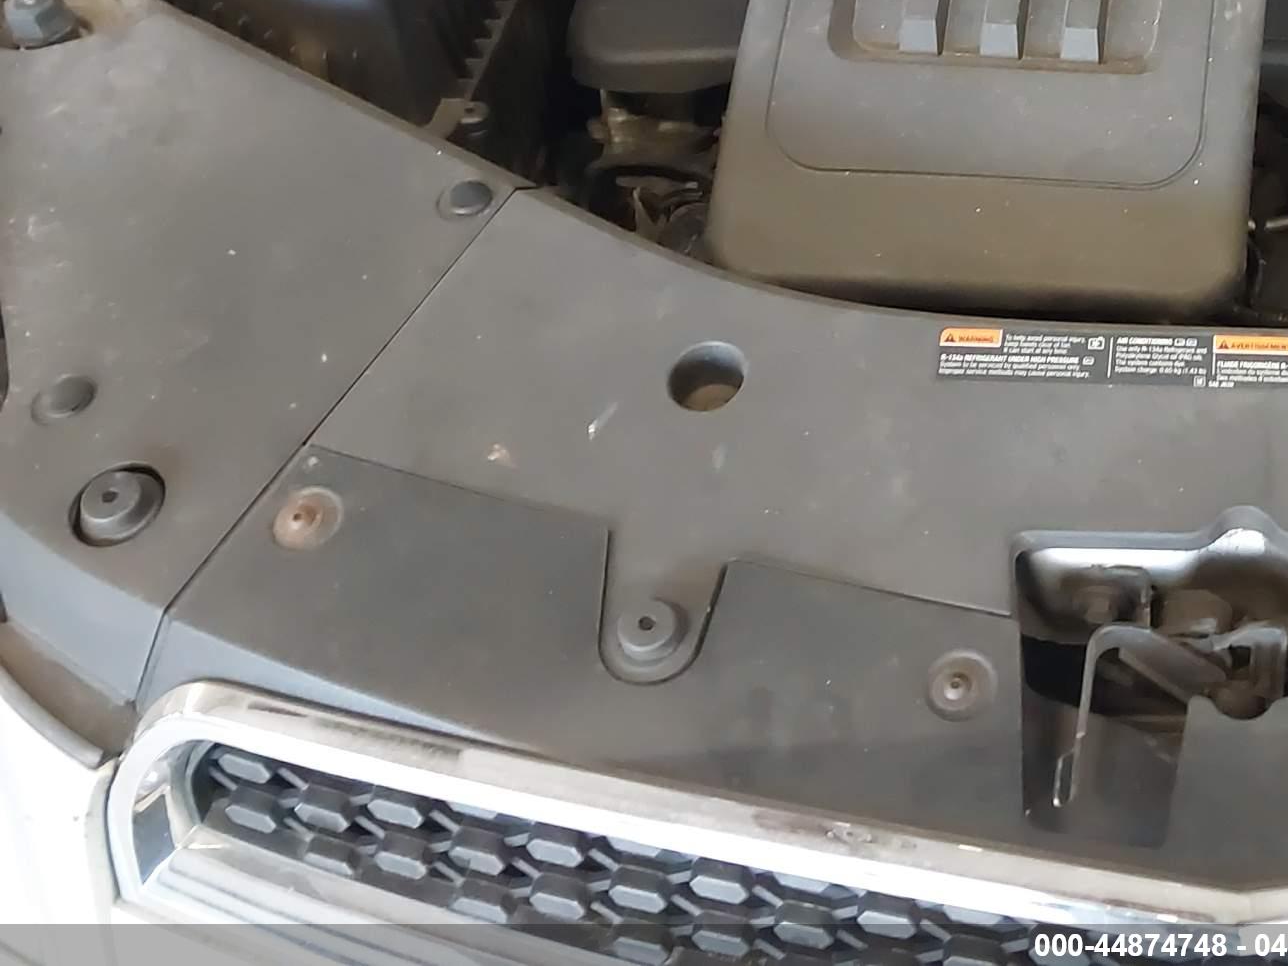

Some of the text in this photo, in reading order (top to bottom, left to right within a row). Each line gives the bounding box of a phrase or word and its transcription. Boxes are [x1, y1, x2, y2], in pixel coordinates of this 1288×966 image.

[958, 335, 993, 343] WARNING
[964, 354, 1006, 362] REFRIGERANT
[1007, 355, 1029, 363] UNDER
